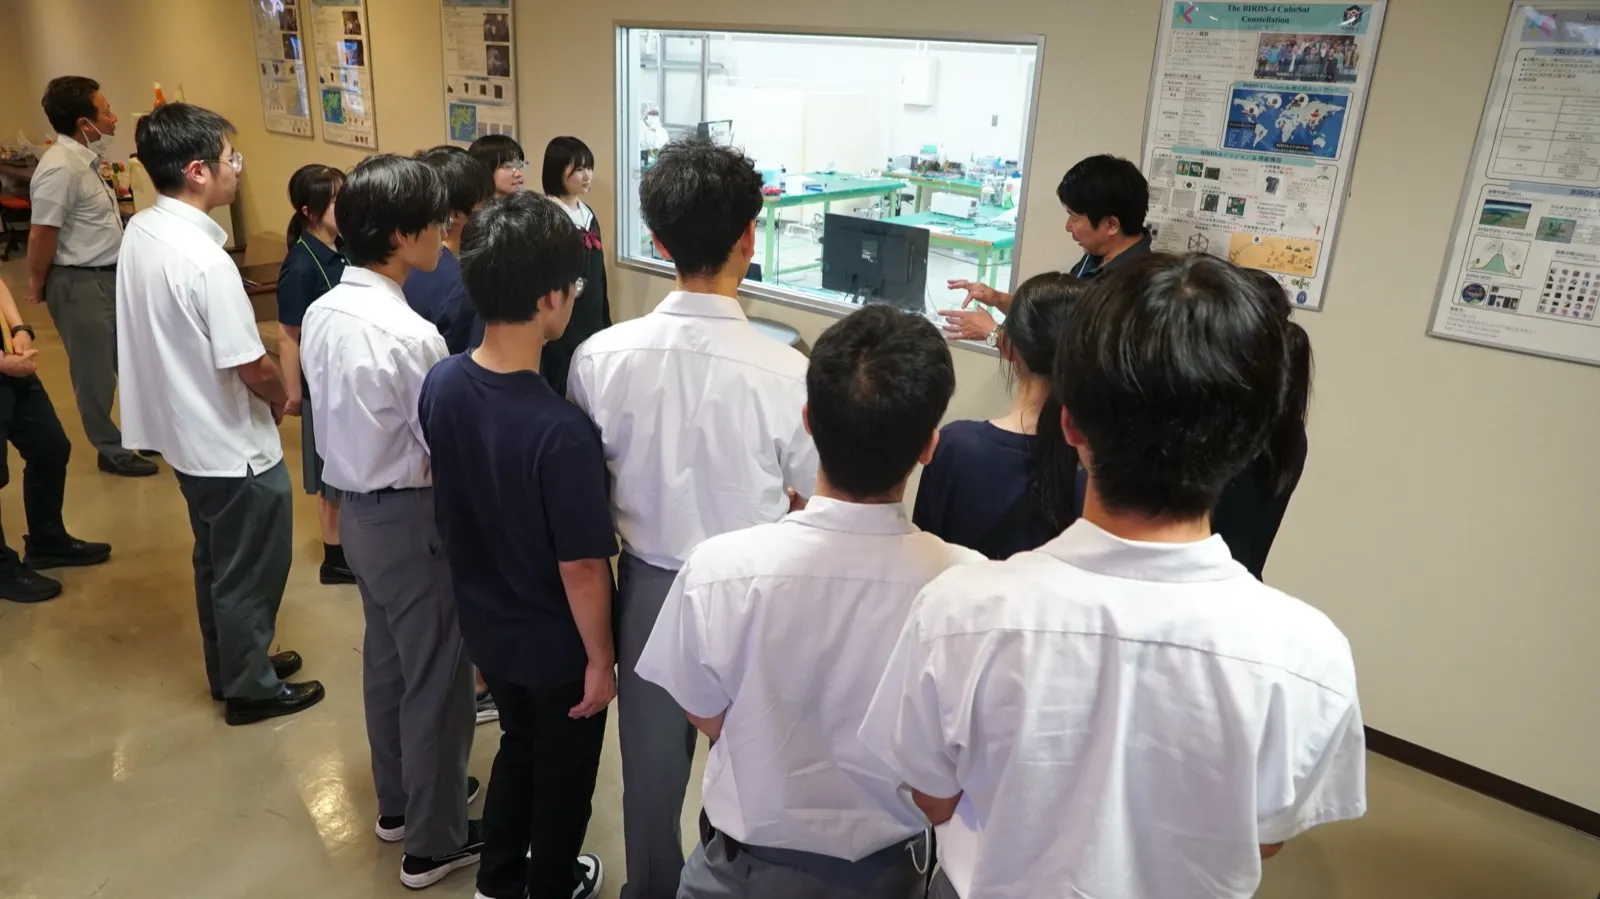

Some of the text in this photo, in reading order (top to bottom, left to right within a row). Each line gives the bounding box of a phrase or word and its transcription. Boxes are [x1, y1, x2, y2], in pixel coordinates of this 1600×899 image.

[1228, 4, 1310, 14] The BIRDS-4 CubeSat
[1241, 15, 1290, 24] Constellation
